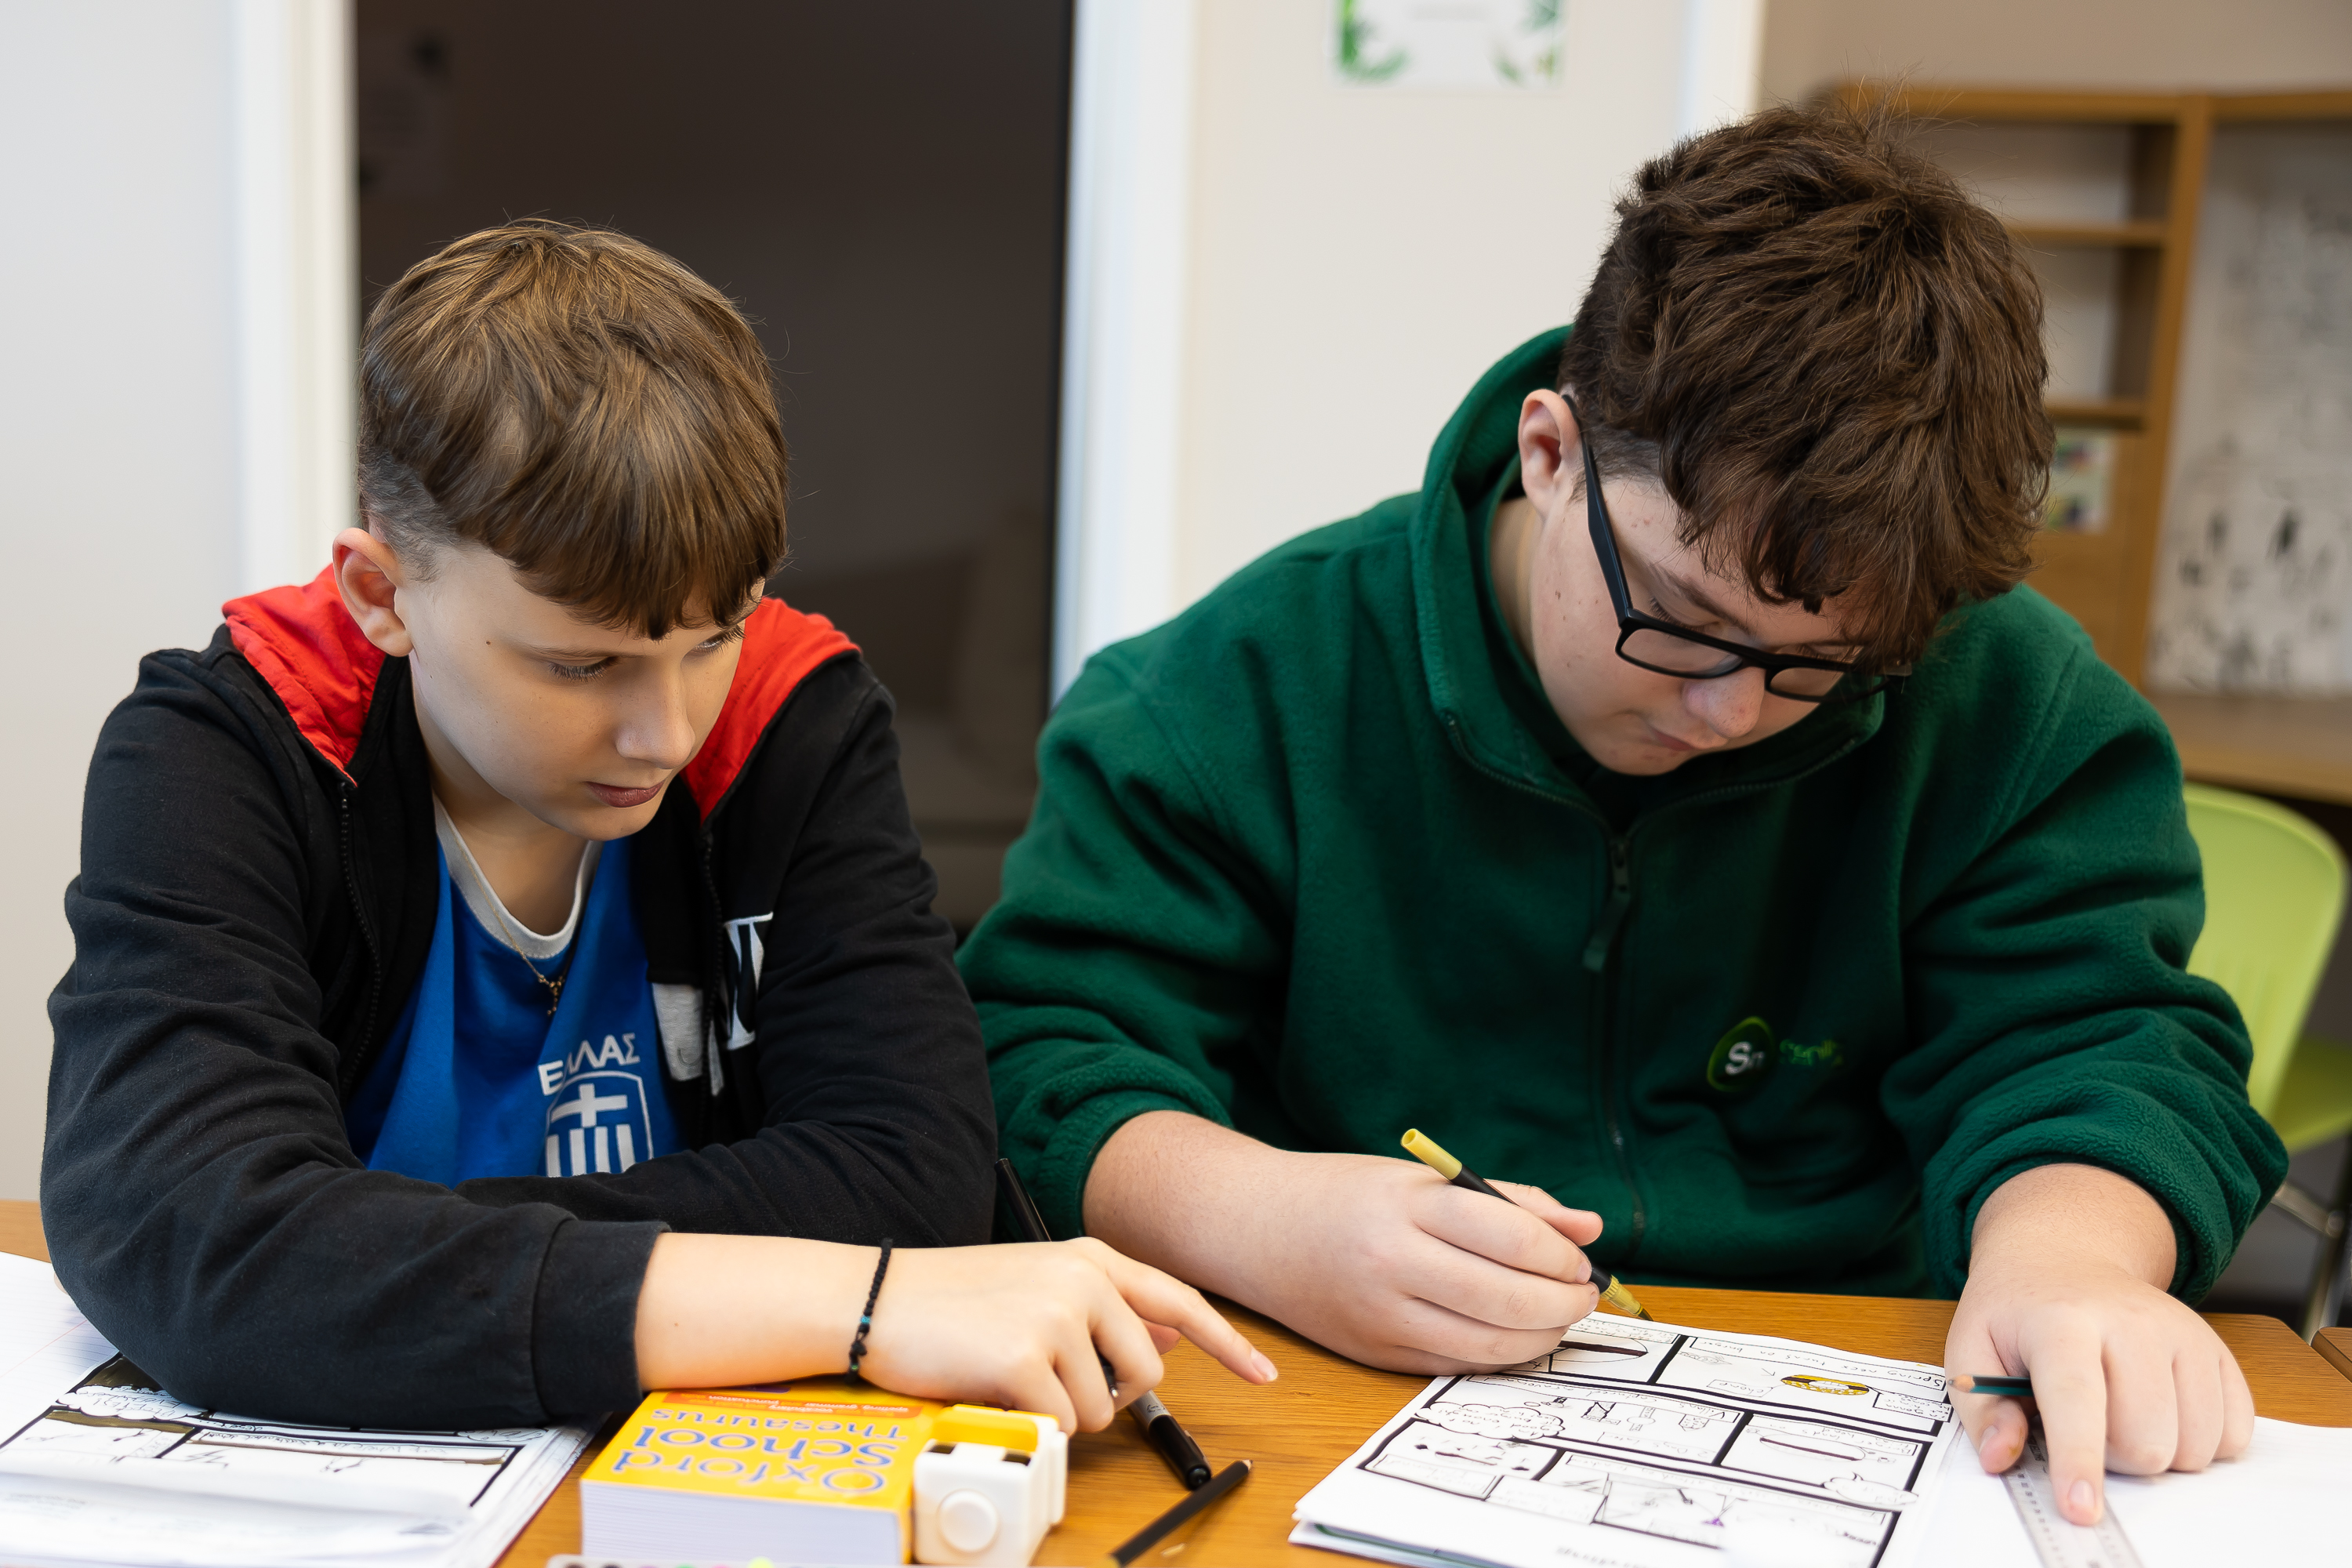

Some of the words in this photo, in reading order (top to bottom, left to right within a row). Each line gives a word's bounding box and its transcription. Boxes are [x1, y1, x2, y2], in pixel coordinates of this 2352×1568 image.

[1887, 1370, 1944, 1387] Spring
[650, 1408, 908, 1440] Thesaurus
[633, 1425, 898, 1467] School
[611, 1450, 887, 1494] Oxford
